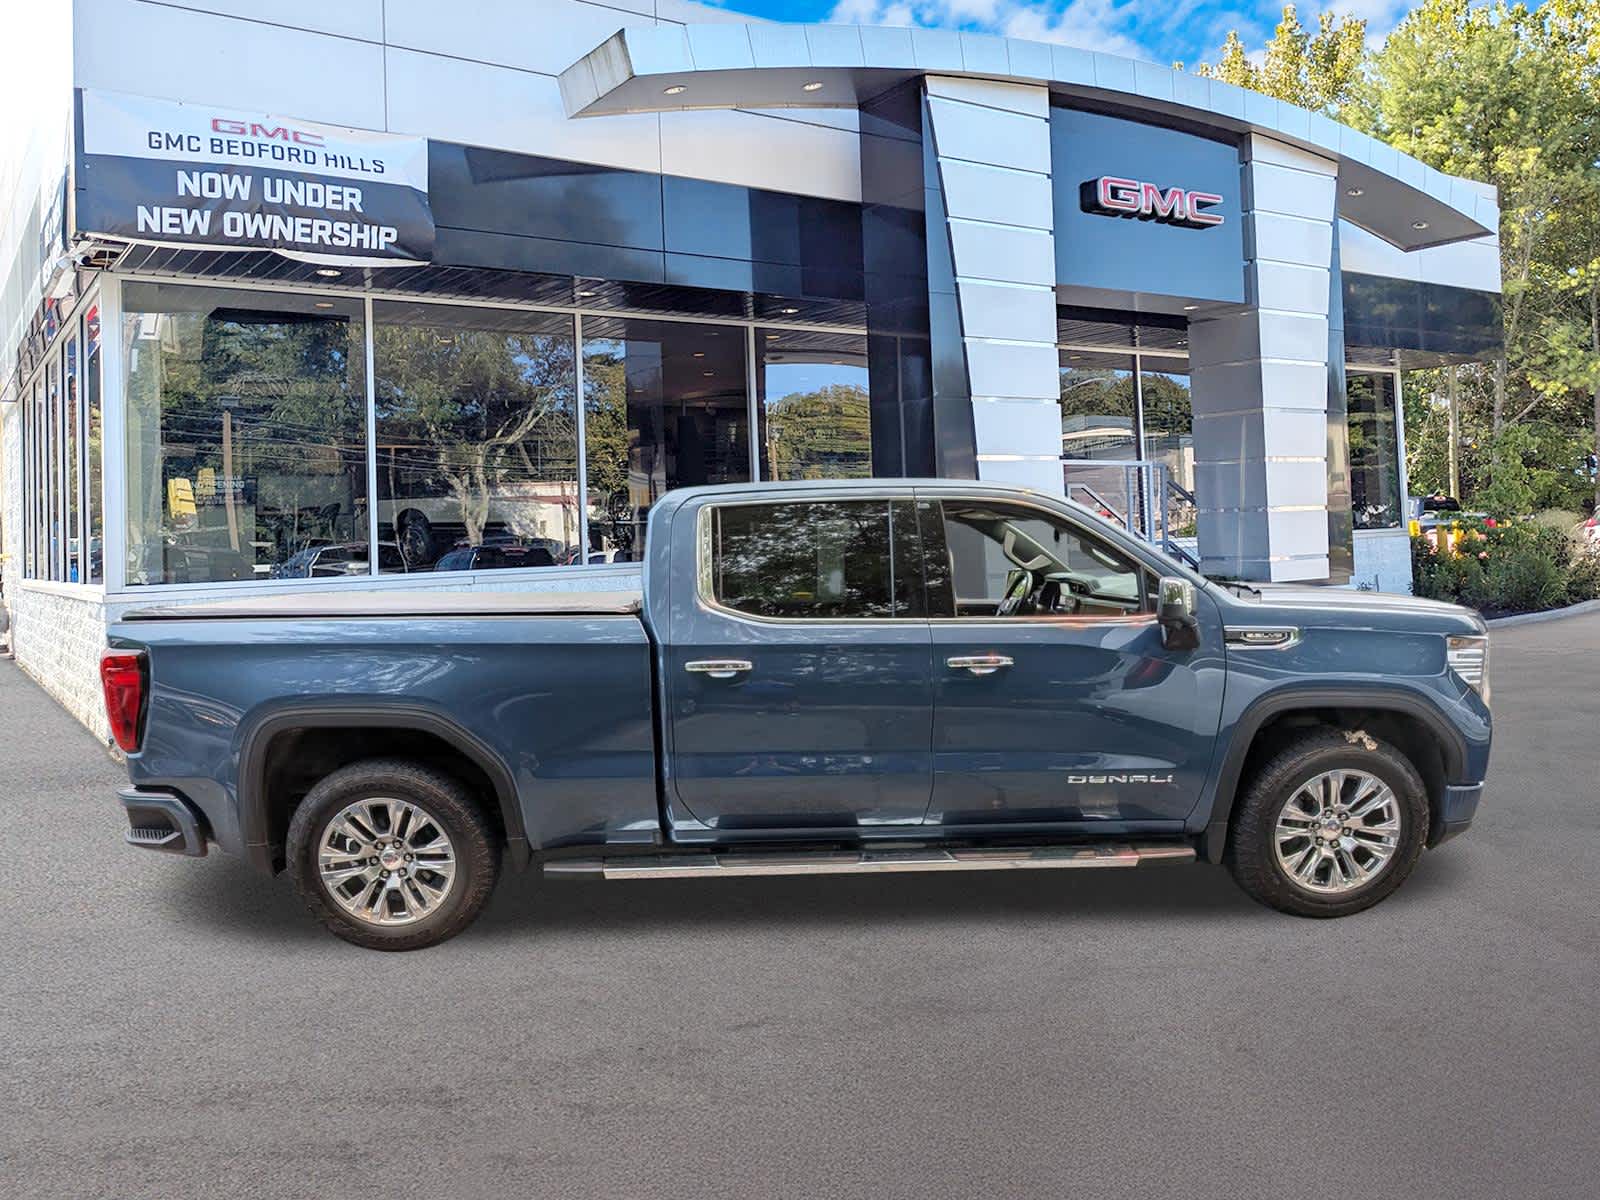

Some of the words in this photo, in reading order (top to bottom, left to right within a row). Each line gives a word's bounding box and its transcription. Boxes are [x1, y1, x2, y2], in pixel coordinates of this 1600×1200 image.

[148, 131, 201, 151] GMC
[210, 139, 317, 165] BEDFORD
[324, 153, 385, 174] HILLS
[211, 118, 325, 148] GMC
[177, 171, 251, 201] NOW
[264, 178, 363, 212] UNDER
[1096, 175, 1224, 225] GMC
[137, 206, 211, 236] NEW
[223, 211, 398, 249] OWNERSHIP
[1067, 775, 1173, 784] DENALI
